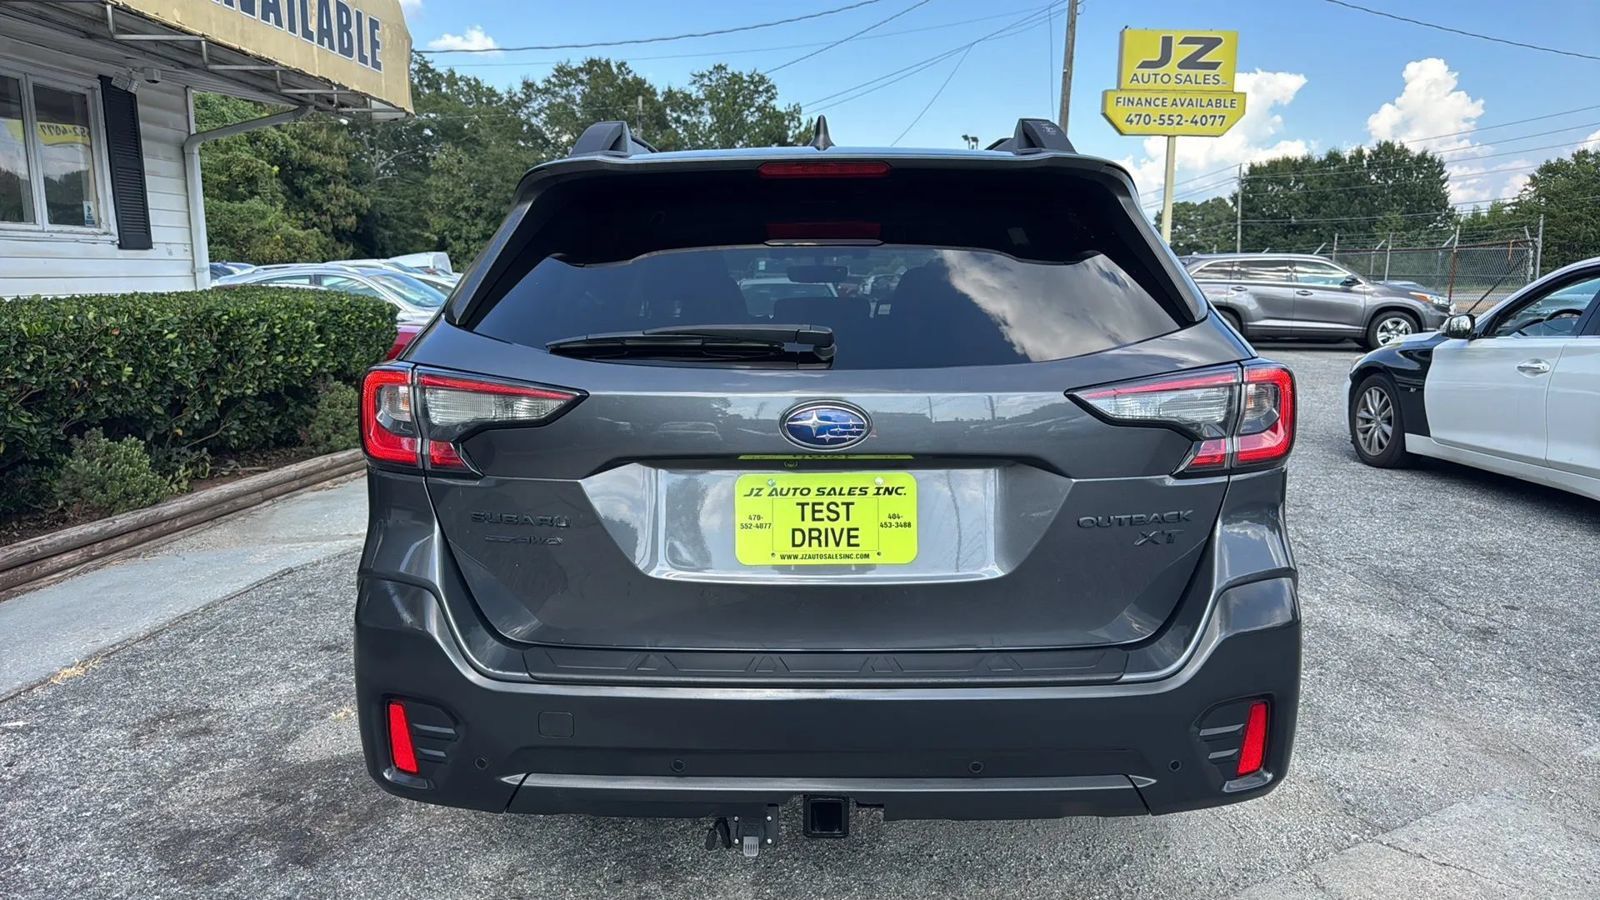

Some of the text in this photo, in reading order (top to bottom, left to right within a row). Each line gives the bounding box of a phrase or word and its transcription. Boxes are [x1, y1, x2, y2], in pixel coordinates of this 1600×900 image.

[1136, 36, 1224, 70] JZ
[1130, 73, 1220, 85] AUTO SALES
[1115, 97, 1237, 109] FINANCE AVAILABLE
[1125, 113, 1226, 127] 470-552-4077
[743, 486, 907, 497] JZ AUTO SALES INC.
[470, 511, 571, 528] SUBARU
[796, 501, 855, 522] TEST
[1077, 509, 1194, 528] OUTBACK
[791, 528, 860, 548] DRIVE
[1133, 529, 1185, 546] XT
